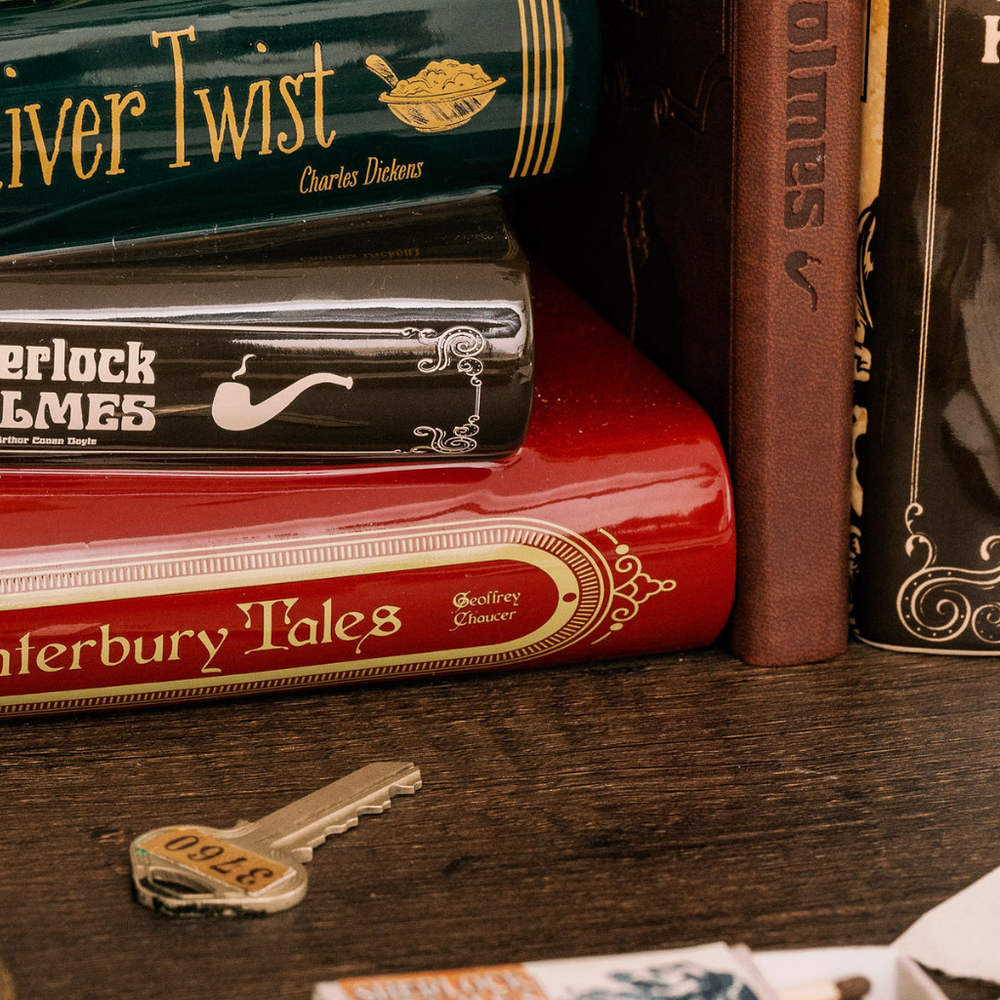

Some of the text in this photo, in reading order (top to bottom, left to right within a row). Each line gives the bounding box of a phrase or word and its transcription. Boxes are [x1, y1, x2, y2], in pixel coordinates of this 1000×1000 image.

[151, 24, 337, 169] Twist
[299, 156, 424, 194] Charles Dickens
[31, 436, 65, 445] Conan
[66, 436, 98, 447] Doyle
[452, 590, 521, 611] Geoffrey
[236, 597, 403, 655] Tales
[449, 610, 517, 632] Chaucer
[164, 834, 274, 885] 3760
